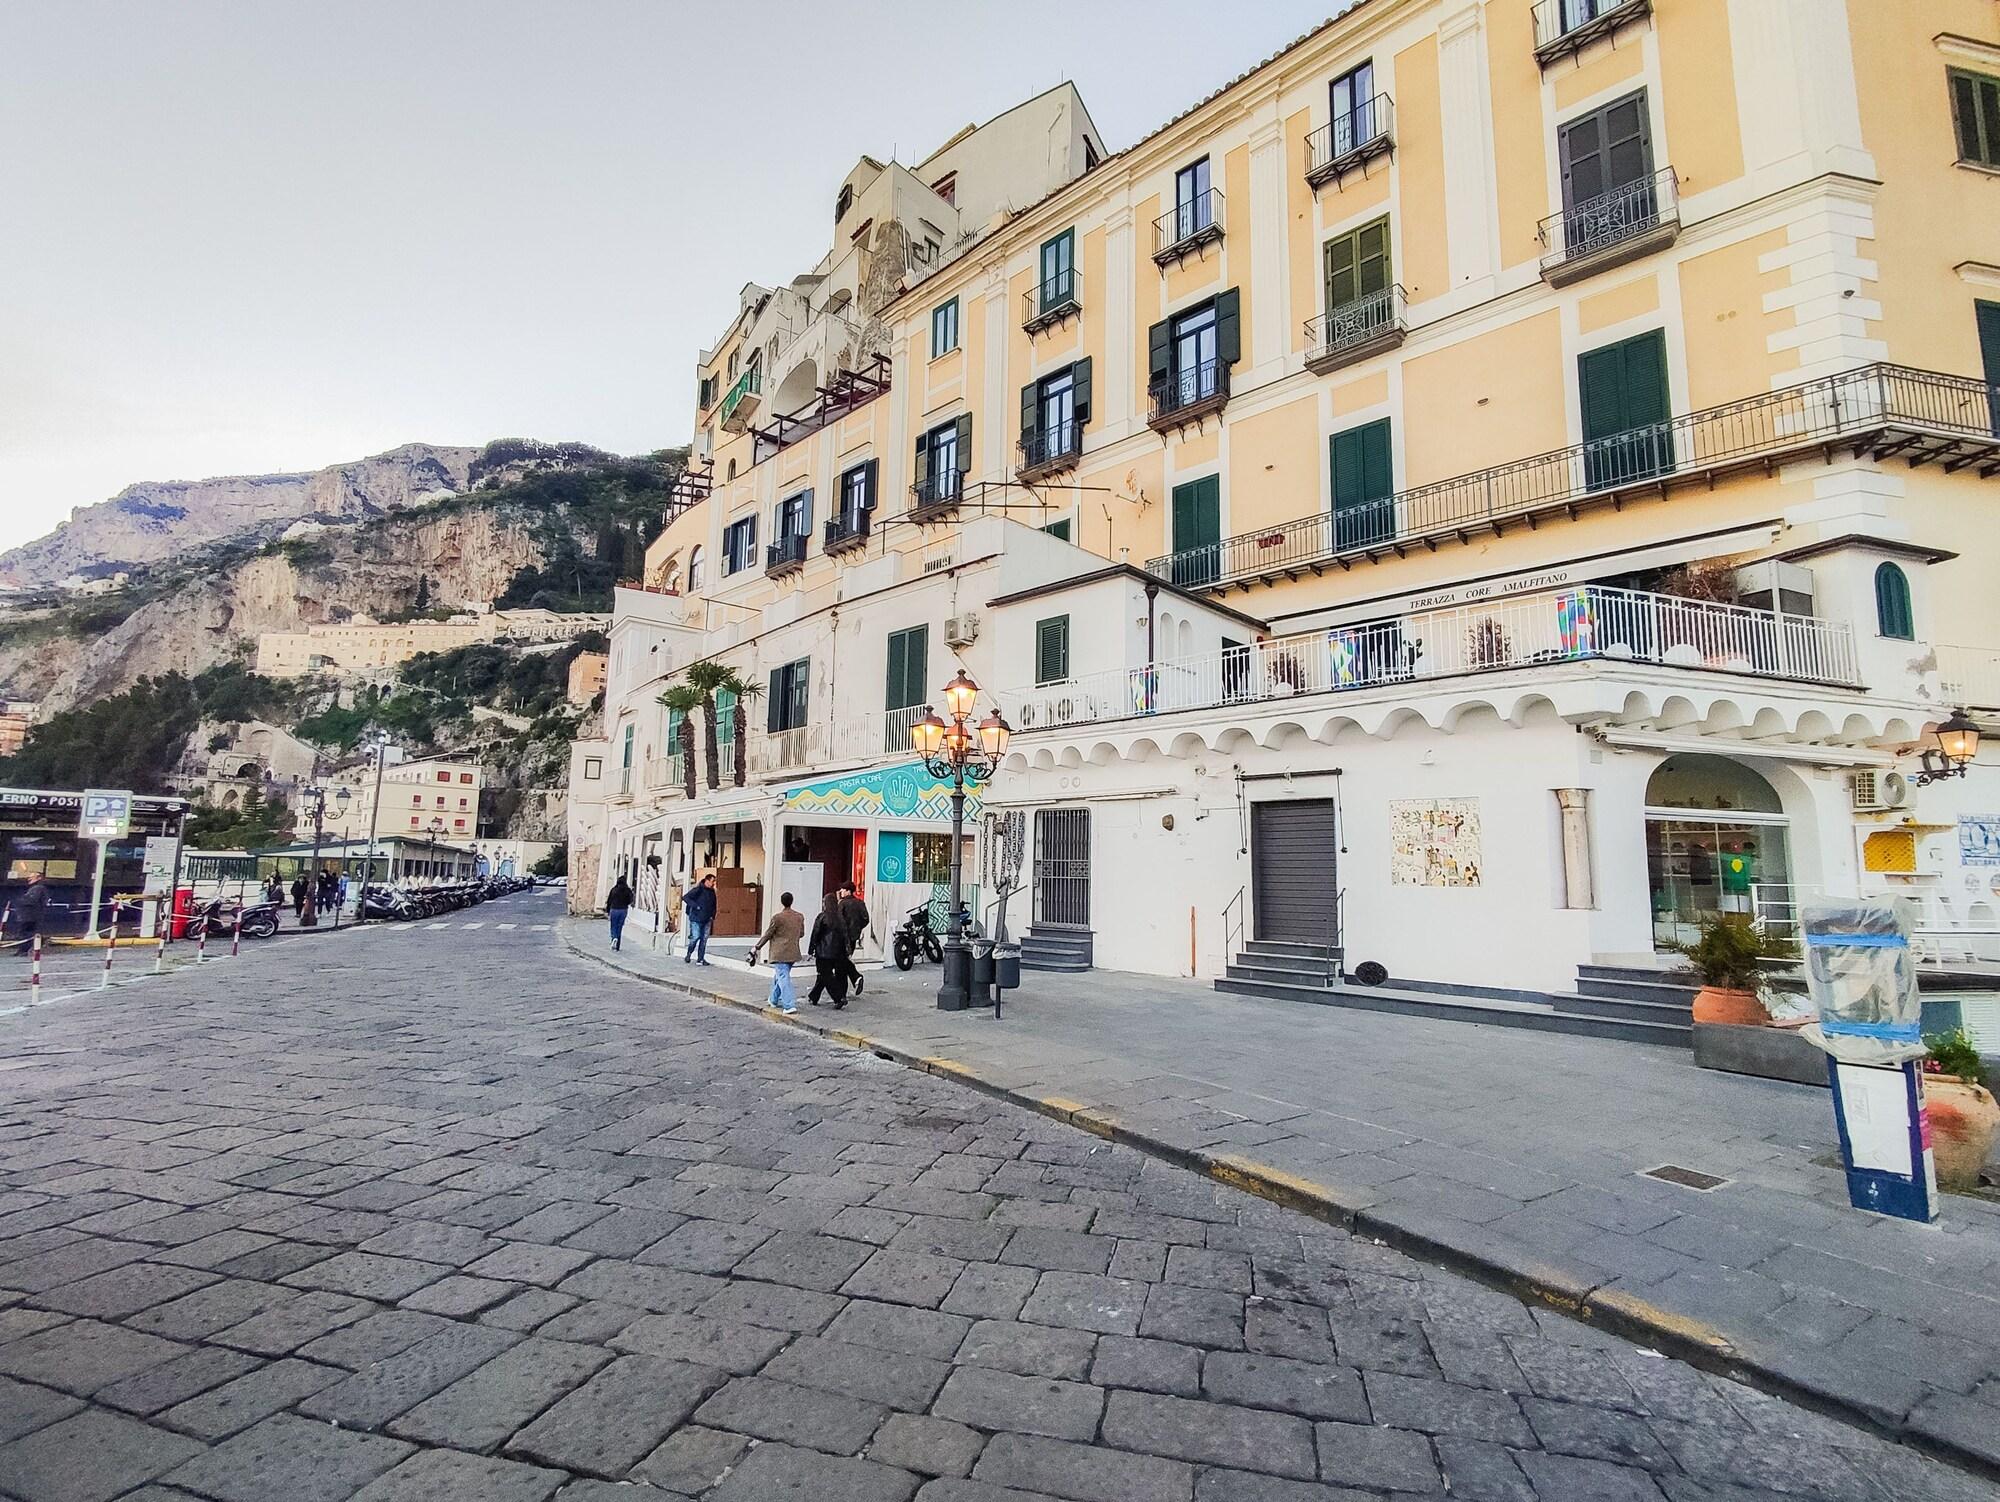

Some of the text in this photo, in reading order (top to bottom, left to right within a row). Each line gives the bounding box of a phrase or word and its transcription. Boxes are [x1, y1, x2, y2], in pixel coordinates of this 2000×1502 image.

[1410, 572, 1568, 609] TERRAZZA CORE AMALFITANO
[87, 798, 108, 817] P
